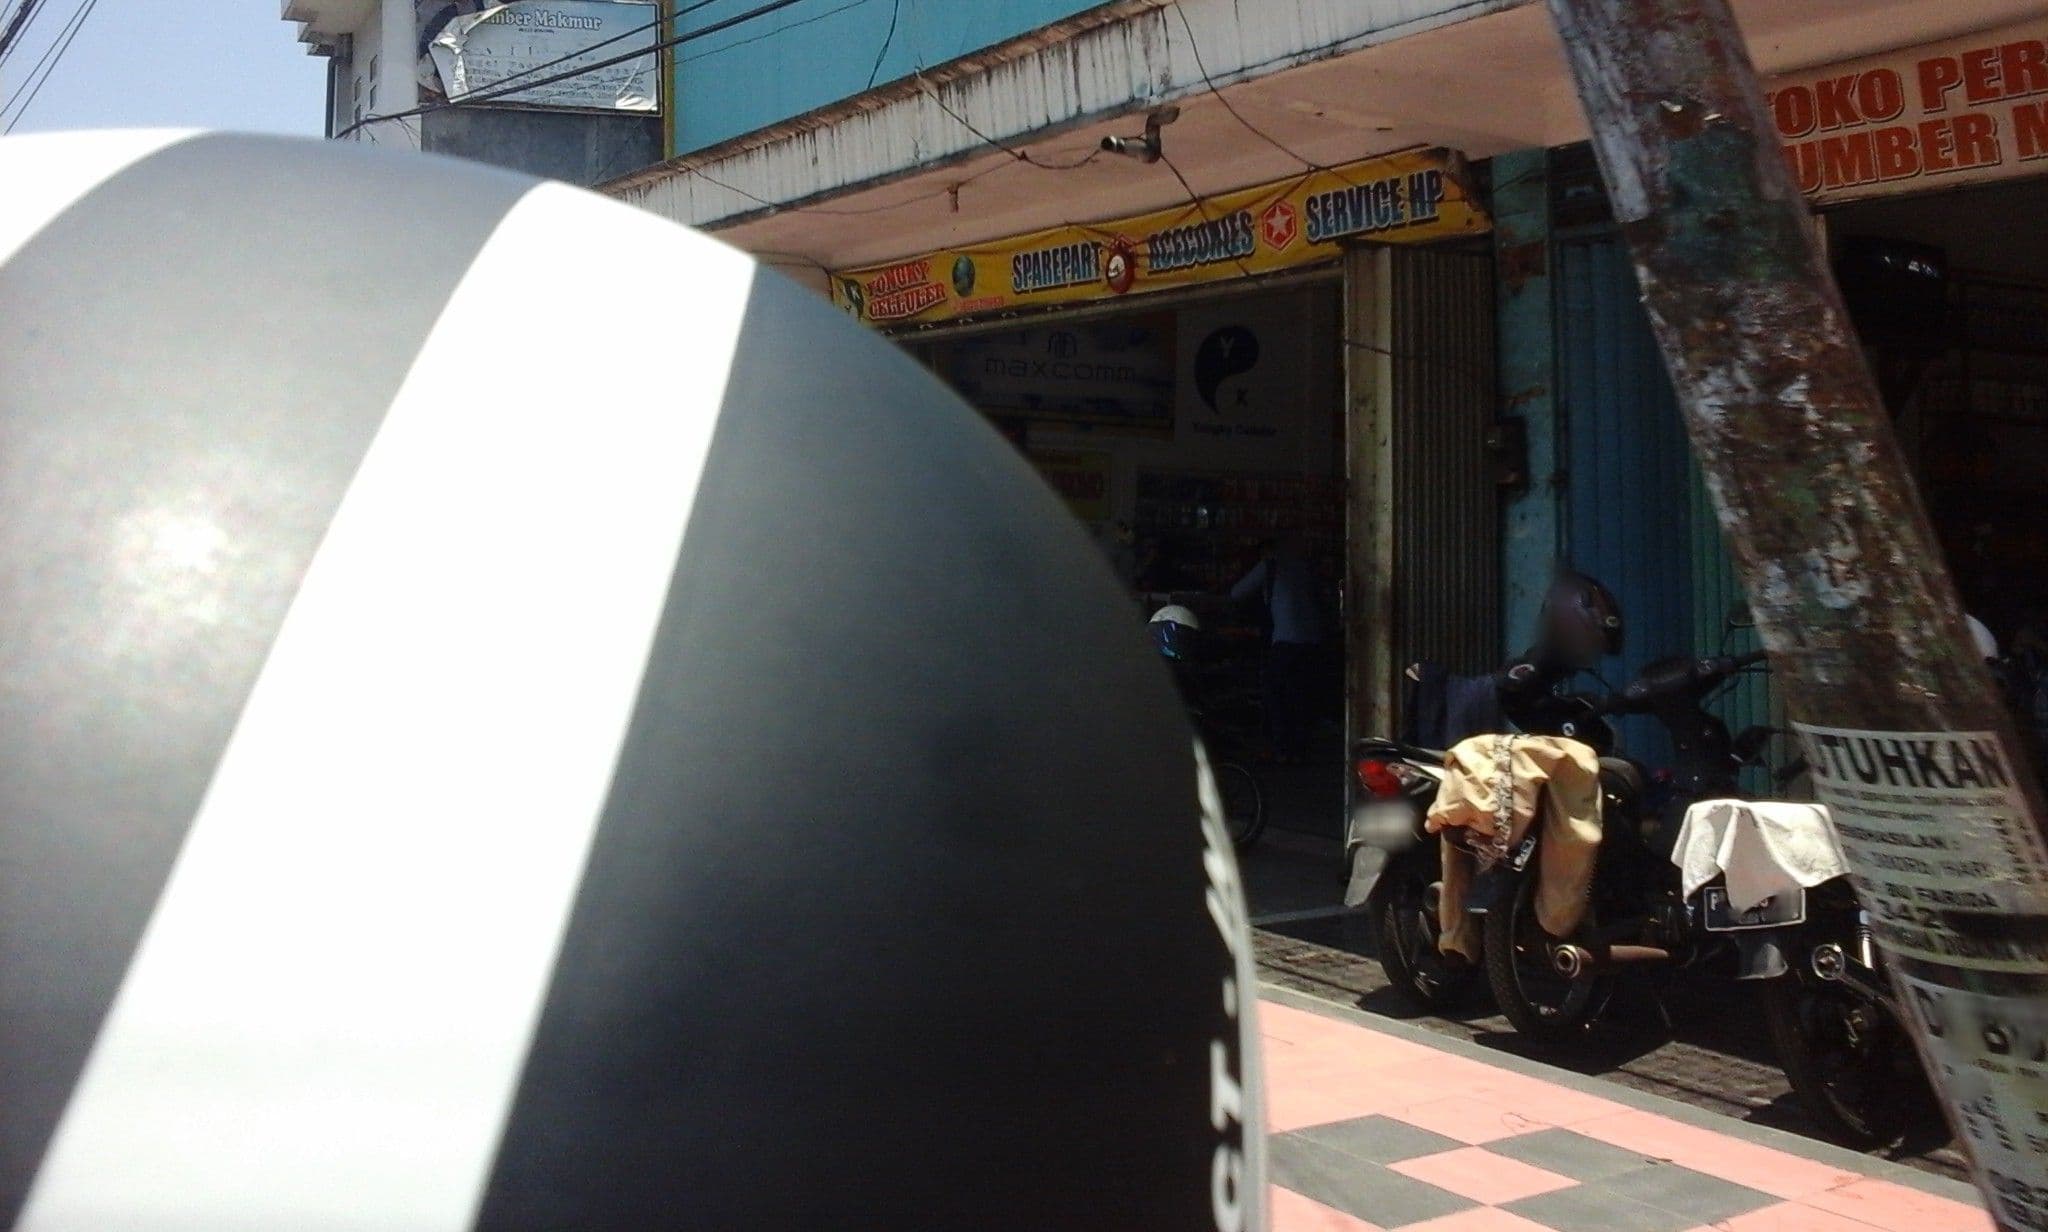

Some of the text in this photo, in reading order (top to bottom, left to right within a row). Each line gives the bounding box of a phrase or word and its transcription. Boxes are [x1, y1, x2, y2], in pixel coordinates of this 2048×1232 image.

[483, 8, 602, 31] mber Makmur
[1012, 240, 1102, 294] SPAREPART
[1304, 177, 1405, 244] SERVICE
[1406, 168, 1445, 220] HP
[1219, 335, 1235, 359] Y
[984, 357, 1137, 384] maxcomm
